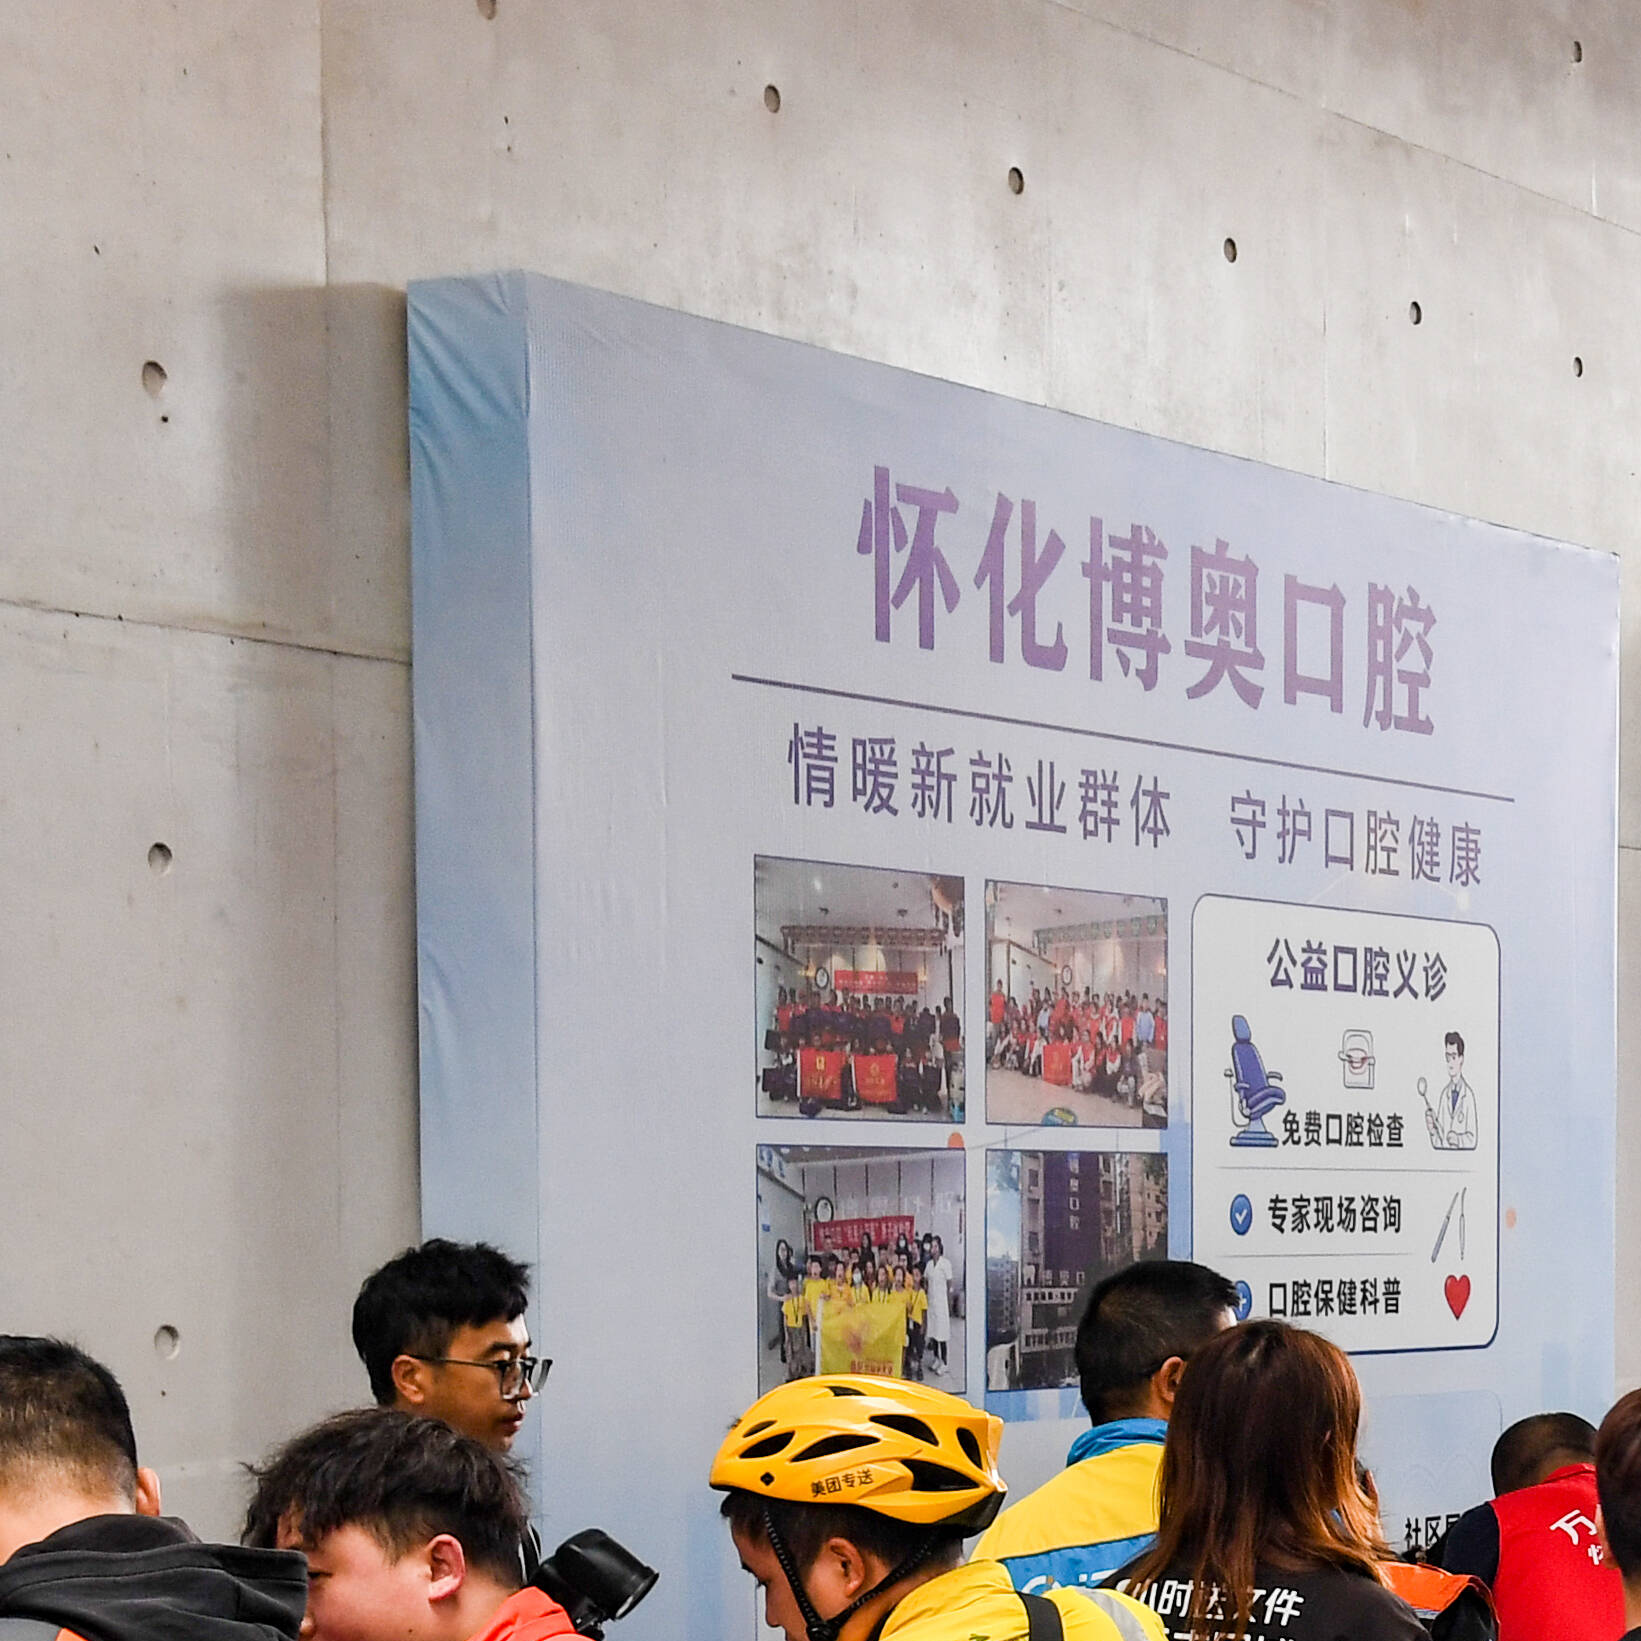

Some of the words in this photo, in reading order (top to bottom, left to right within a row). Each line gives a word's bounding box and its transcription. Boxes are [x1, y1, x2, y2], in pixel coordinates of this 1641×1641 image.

[856, 465, 1436, 737] 怀化博奥口腔
[786, 722, 1172, 850] 情暖新就业群体
[1228, 788, 1483, 888] 守护口腔健康
[1266, 937, 1448, 1002] 公益口腔义诊
[1281, 1109, 1405, 1149] 免费口腔检查
[1267, 1194, 1402, 1235] 专家现场咨询
[1268, 1275, 1402, 1318] 口腔保健科普
[809, 1469, 874, 1498] 美团专送
